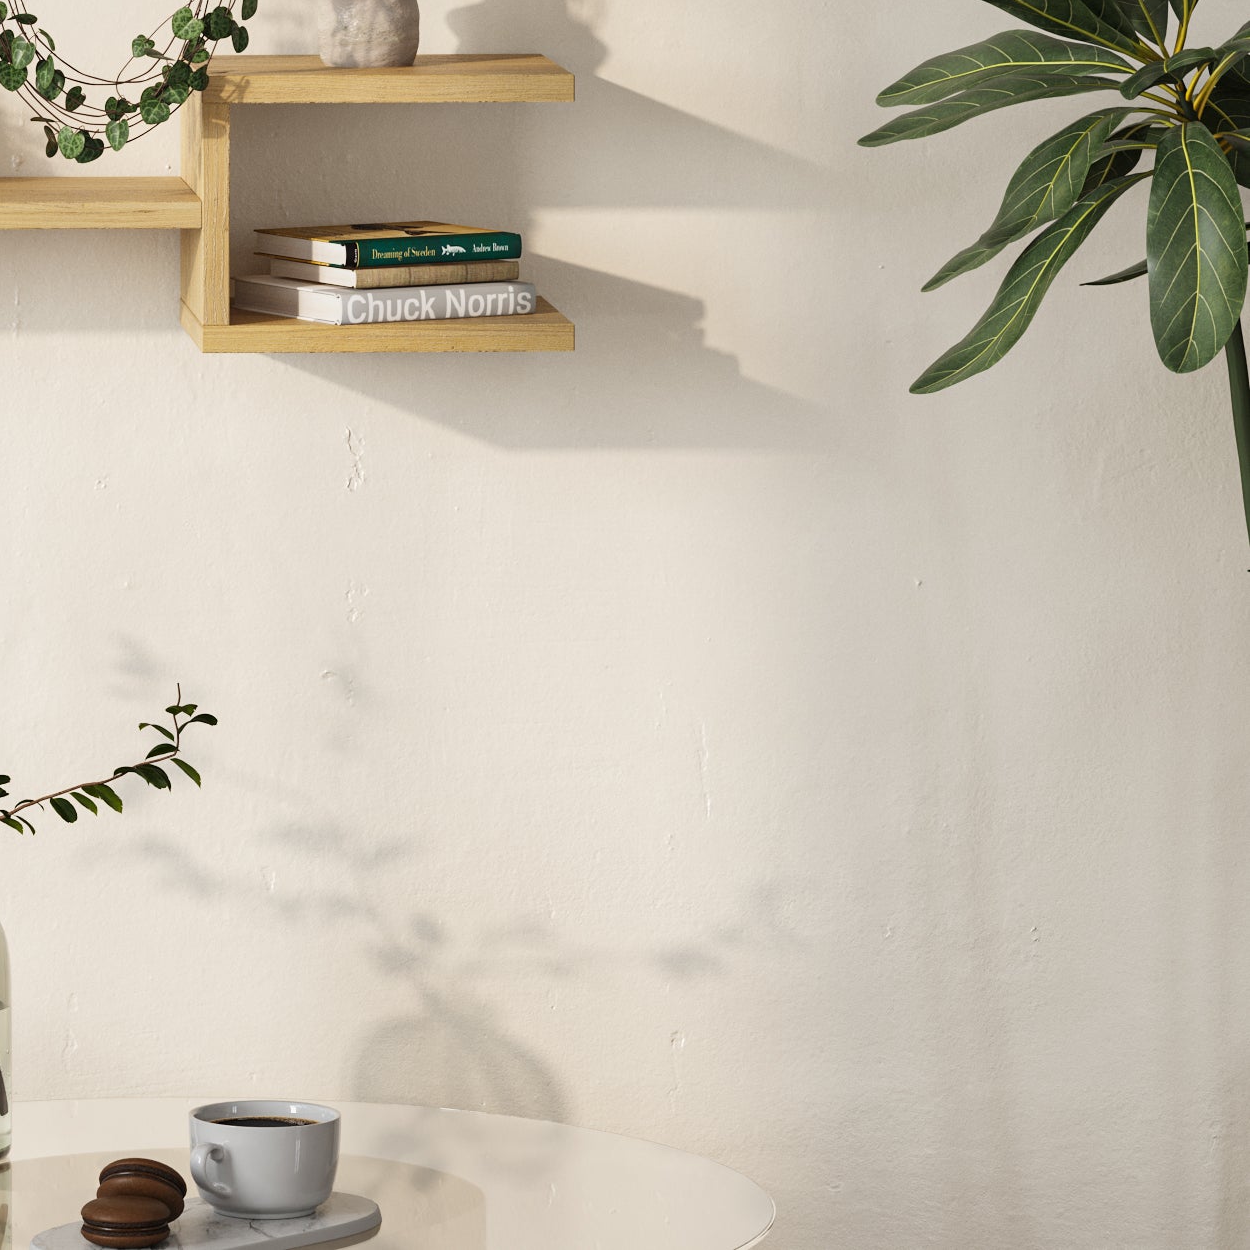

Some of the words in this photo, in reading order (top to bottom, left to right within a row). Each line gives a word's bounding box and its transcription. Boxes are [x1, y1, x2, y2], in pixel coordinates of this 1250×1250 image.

[372, 247, 403, 261] Dreaming
[403, 246, 411, 258] of
[411, 245, 436, 257] Sweden
[472, 243, 491, 253] Andrew
[492, 242, 509, 252] Brown
[346, 290, 436, 324] Chuck
[445, 285, 532, 318] Norris
